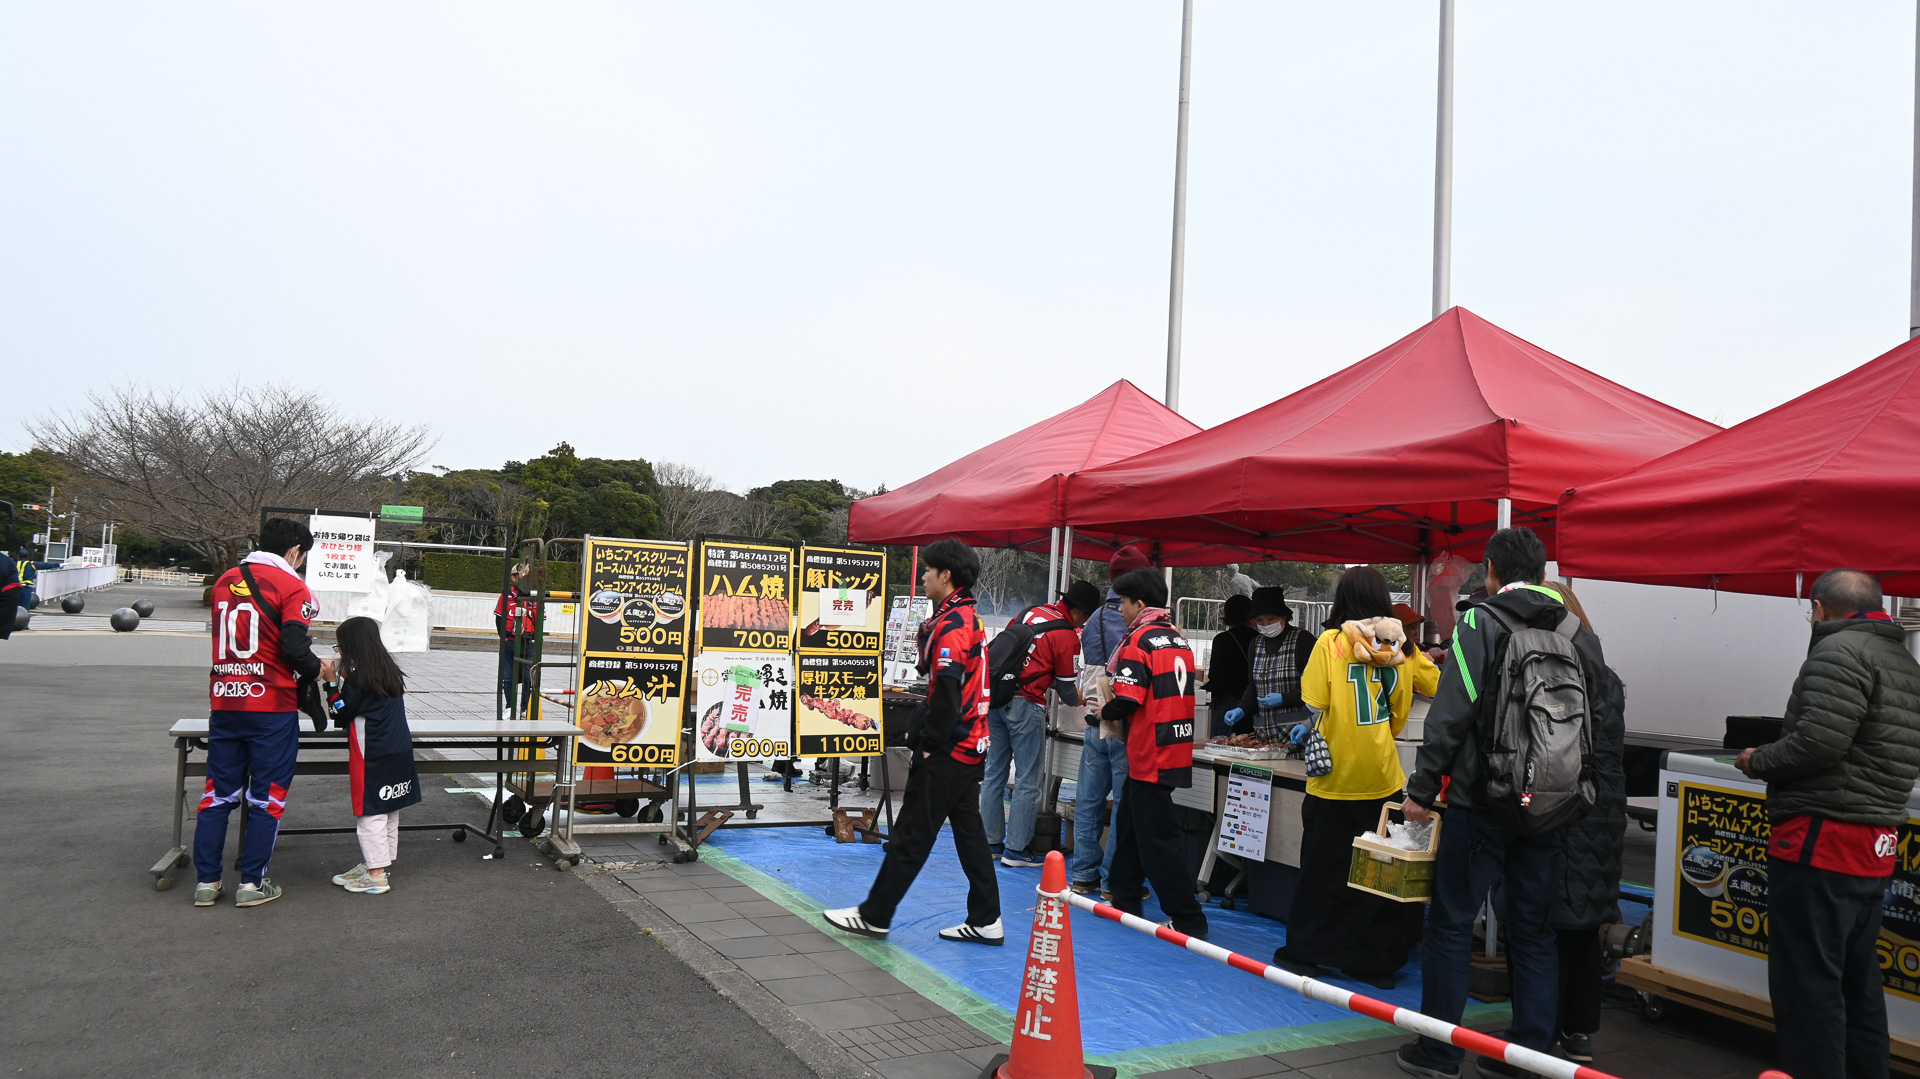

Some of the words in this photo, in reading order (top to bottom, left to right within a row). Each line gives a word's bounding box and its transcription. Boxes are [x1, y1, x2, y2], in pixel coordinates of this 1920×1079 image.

[312, 531, 371, 542] お持ち帰り袋は
[320, 542, 363, 552] おひとり様
[325, 553, 356, 561] 1枚まで
[595, 547, 686, 565] いちごアイスクリーム
[707, 548, 726, 559] 特許
[729, 550, 787, 564] 第4874412号
[836, 557, 880, 568] 第5195327号
[323, 562, 357, 570] でお願い
[595, 561, 685, 578] ロースハムアイスクリーム
[707, 559, 737, 569] 商標登録
[740, 561, 787, 573] 第5085201号
[318, 571, 360, 579] いたします
[806, 567, 880, 591] 豚ドッグ
[594, 579, 683, 596] ベーコンアイスクリーム
[708, 573, 785, 600] ハム焼
[832, 599, 854, 611] 完売
[218, 601, 259, 660] 10
[619, 626, 682, 645] 500円
[733, 630, 789, 648] 700円
[826, 631, 878, 649] 500円
[588, 659, 622, 670] 商標登録
[624, 661, 679, 672] 第5199157号
[831, 658, 876, 667] 第5640553号
[800, 670, 878, 685] 厚切スモーク
[587, 674, 676, 705] ハム汁
[813, 685, 867, 700] 牛タン焼
[730, 683, 753, 723] 完売
[730, 738, 789, 758] 900円
[820, 736, 879, 752] 1100円
[611, 745, 675, 763] 600円
[1239, 766, 1263, 778] CASHLESS
[1687, 809, 1772, 838] ロースハムアイス
[1687, 833, 1768, 862] ベーコンアイス
[1020, 896, 1064, 1041] 駐車禁止
